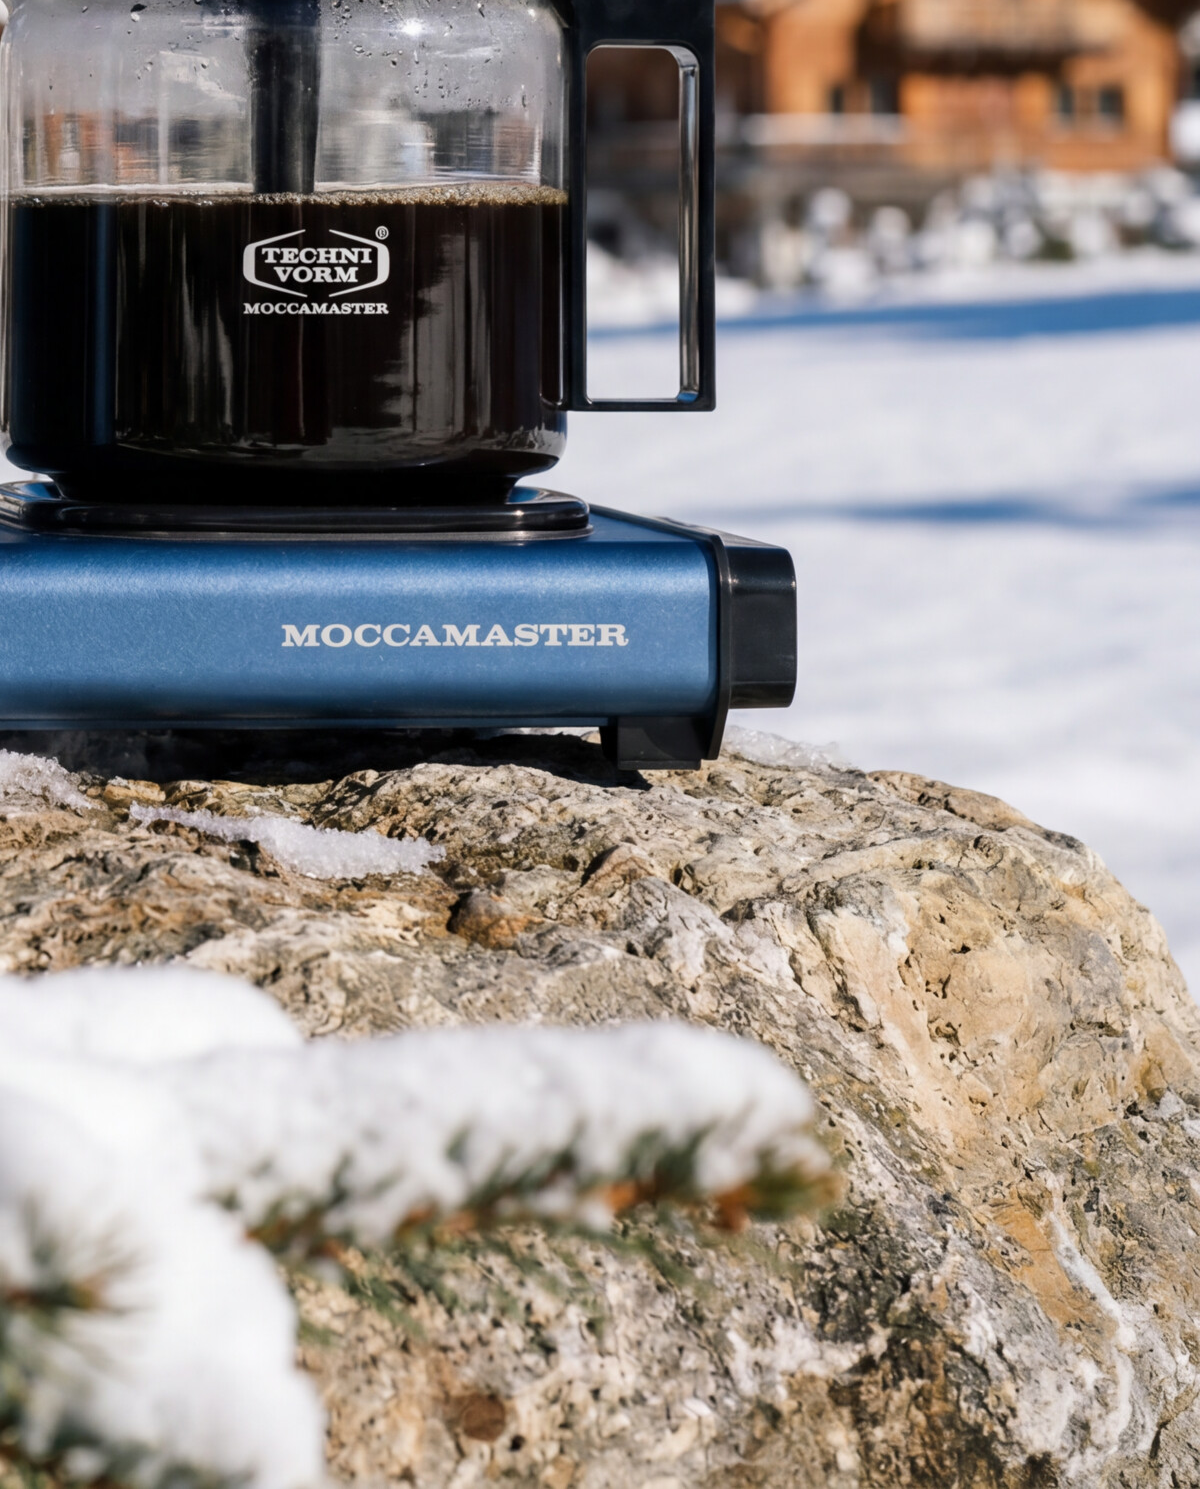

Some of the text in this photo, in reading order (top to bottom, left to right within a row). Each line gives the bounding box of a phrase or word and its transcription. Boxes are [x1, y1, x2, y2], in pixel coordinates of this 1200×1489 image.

[261, 247, 373, 264] TECHNI
[273, 266, 359, 283] VORM
[242, 302, 390, 315] MOCCAMASTER
[281, 623, 630, 648] MOCCAMASTER
